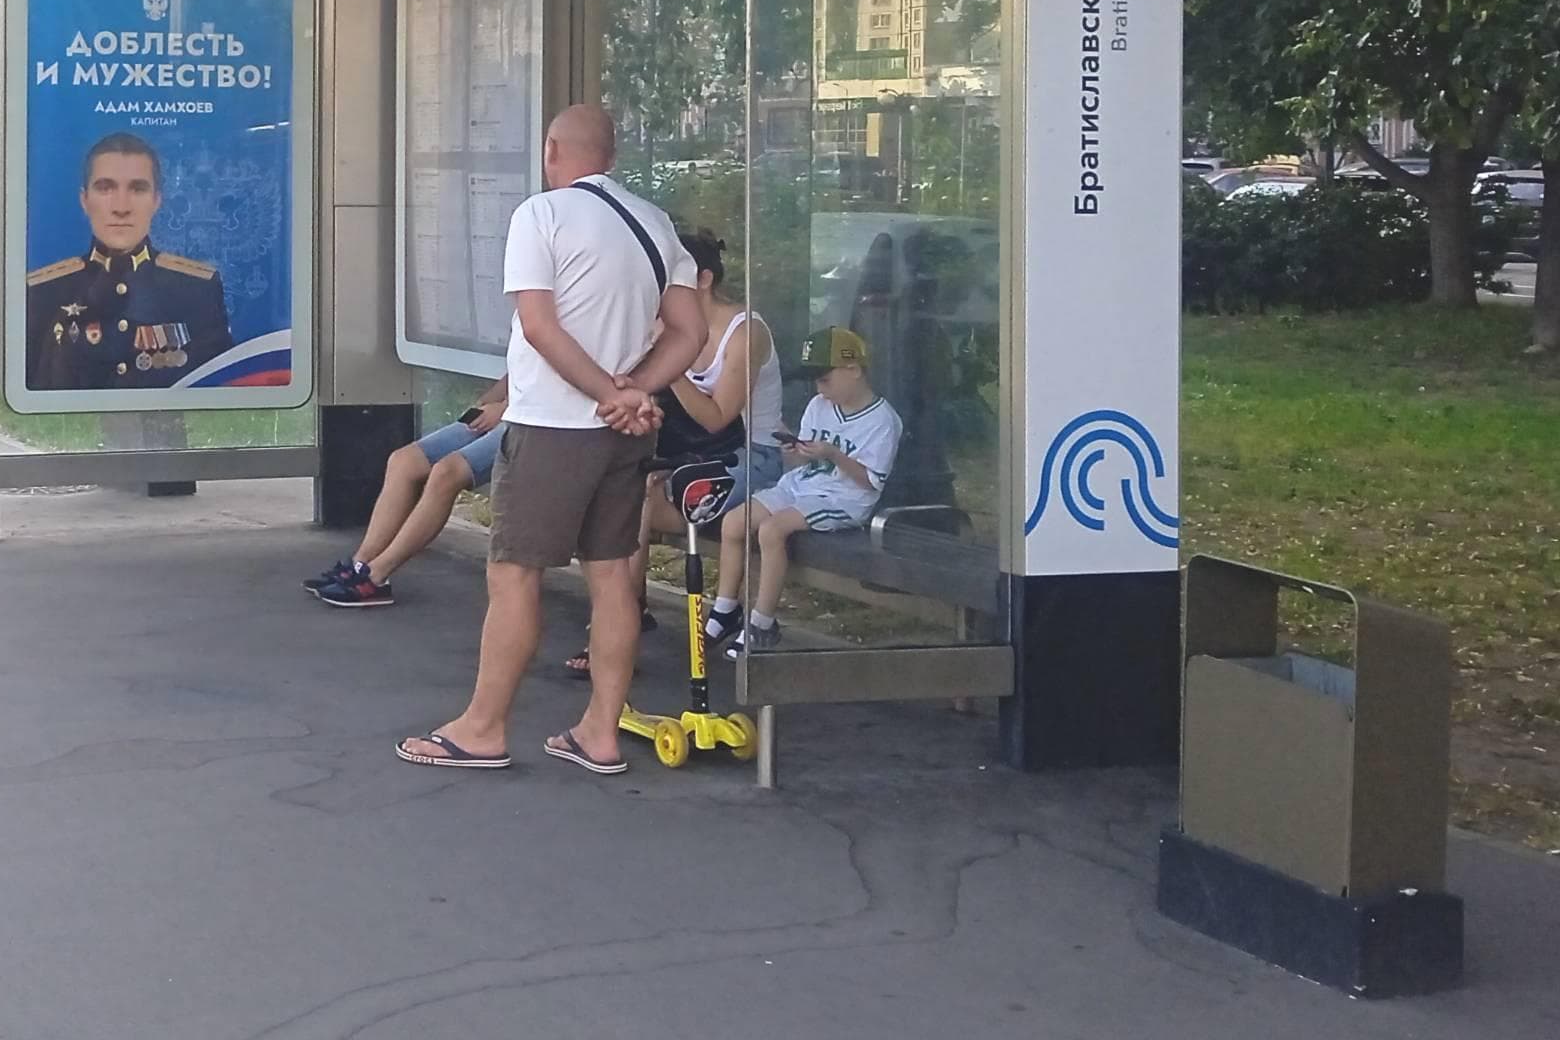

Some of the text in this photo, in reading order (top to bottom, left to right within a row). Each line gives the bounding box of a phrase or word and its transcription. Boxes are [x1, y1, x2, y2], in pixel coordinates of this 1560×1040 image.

[66, 30, 245, 57] ДОБЛЕСТЬ
[36, 61, 272, 89] И МУЖЕСТВО!
[94, 100, 214, 114] АДАМ ХАМХОЕВ
[130, 117, 177, 126] КАПИТАН
